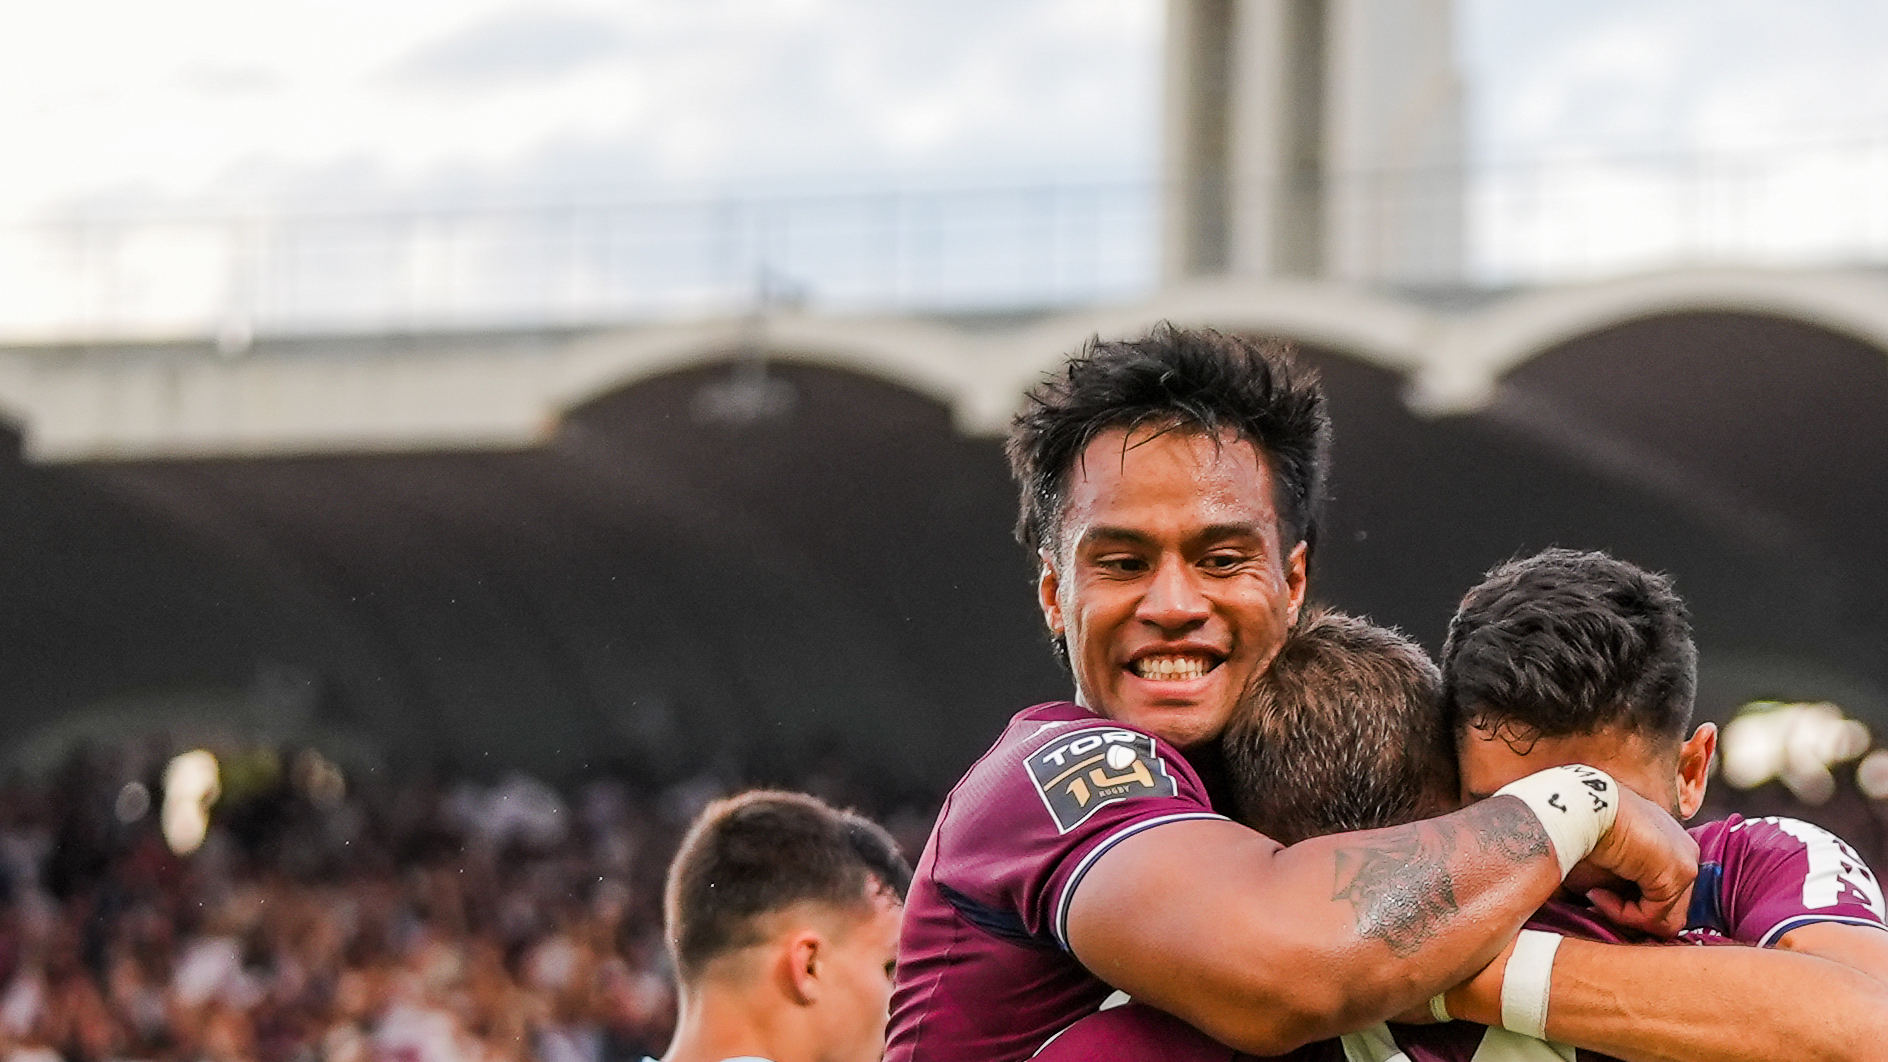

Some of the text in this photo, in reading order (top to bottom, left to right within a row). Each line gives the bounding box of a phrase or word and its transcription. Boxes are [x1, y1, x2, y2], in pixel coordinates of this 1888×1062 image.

[1042, 731, 1136, 766] TOP
[1066, 759, 1155, 808] 14
[1098, 785, 1131, 798] RUGBY
